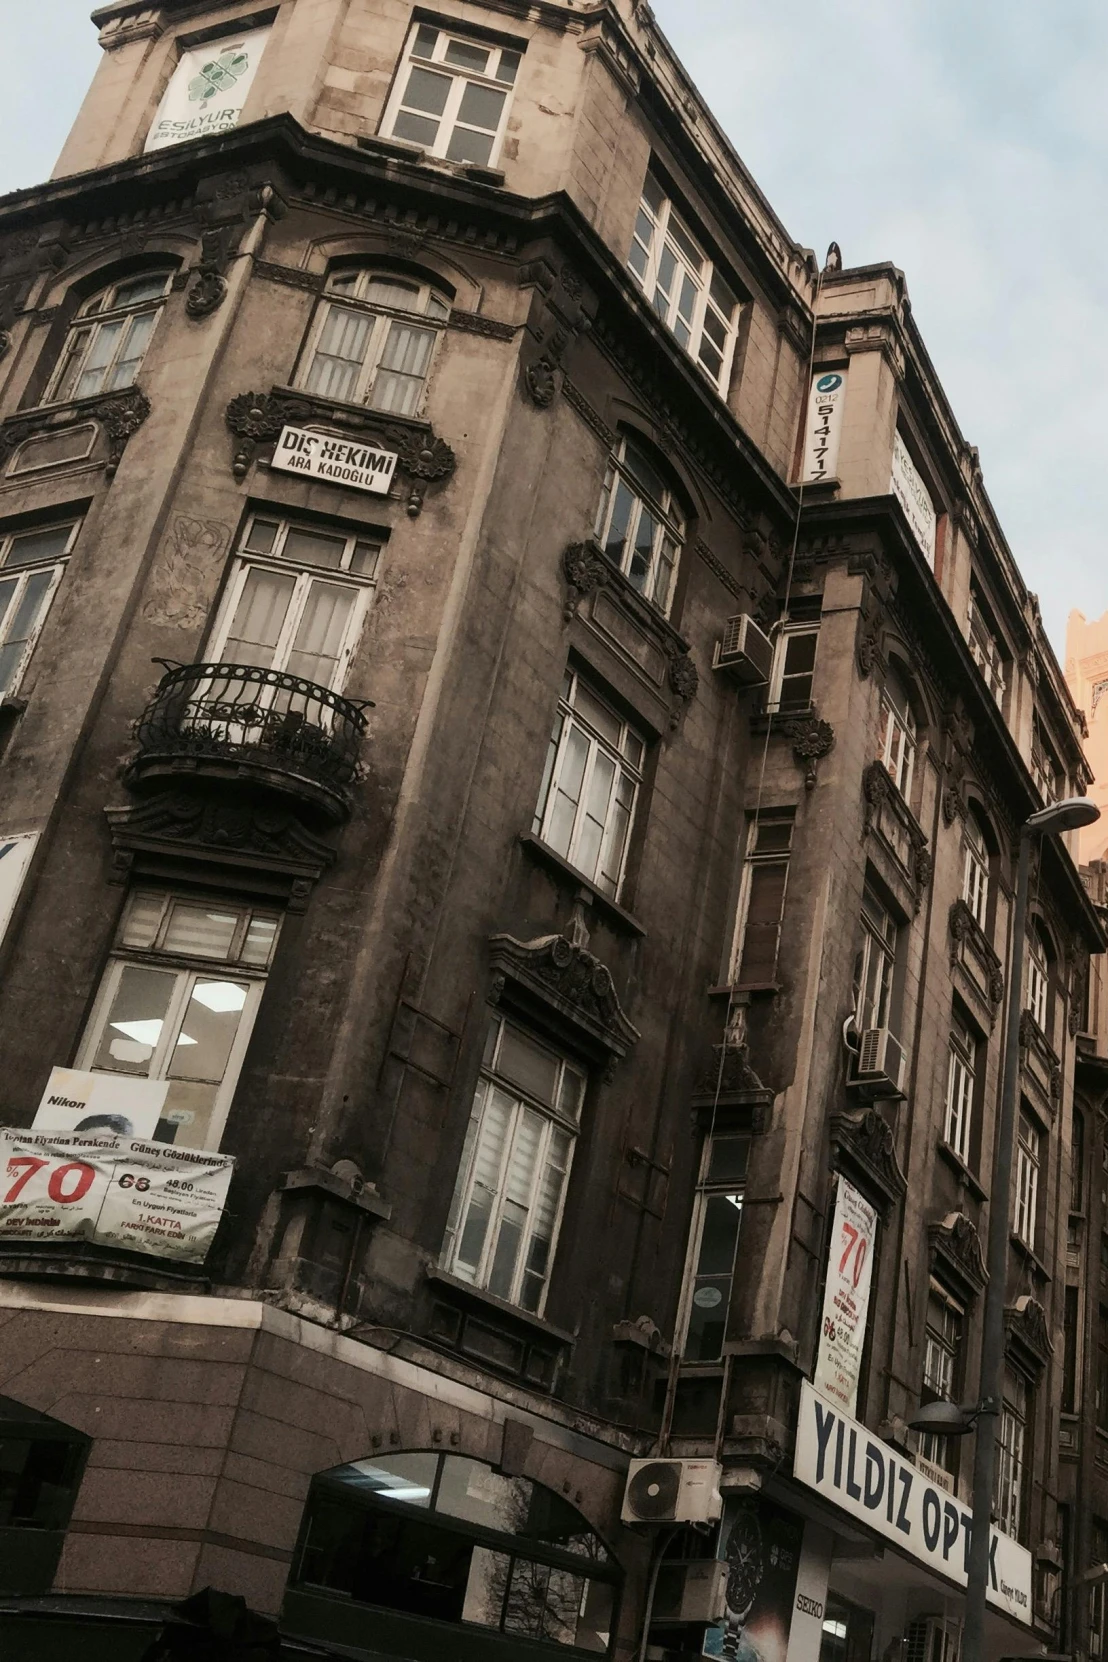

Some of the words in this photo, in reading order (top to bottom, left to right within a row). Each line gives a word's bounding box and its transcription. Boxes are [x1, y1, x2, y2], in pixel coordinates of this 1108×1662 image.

[815, 393, 839, 404] 0212
[282, 431, 319, 456] DİŞ
[320, 440, 394, 475] HEKİMİ
[287, 455, 311, 470] ARA
[317, 461, 374, 486] KADOĞLU
[47, 1096, 87, 1109] Nikon
[72, 1136, 120, 1149] Perakende
[130, 1142, 160, 1157] Güneş
[166, 1179, 194, 1193] 48.00
[6, 1218, 26, 1226] DEV
[138, 1213, 182, 1230] 1.KATTA
[814, 1399, 914, 1536] YILDIZ
[922, 1487, 999, 1593] OPTK
[796, 1593, 823, 1620] SEIKO
